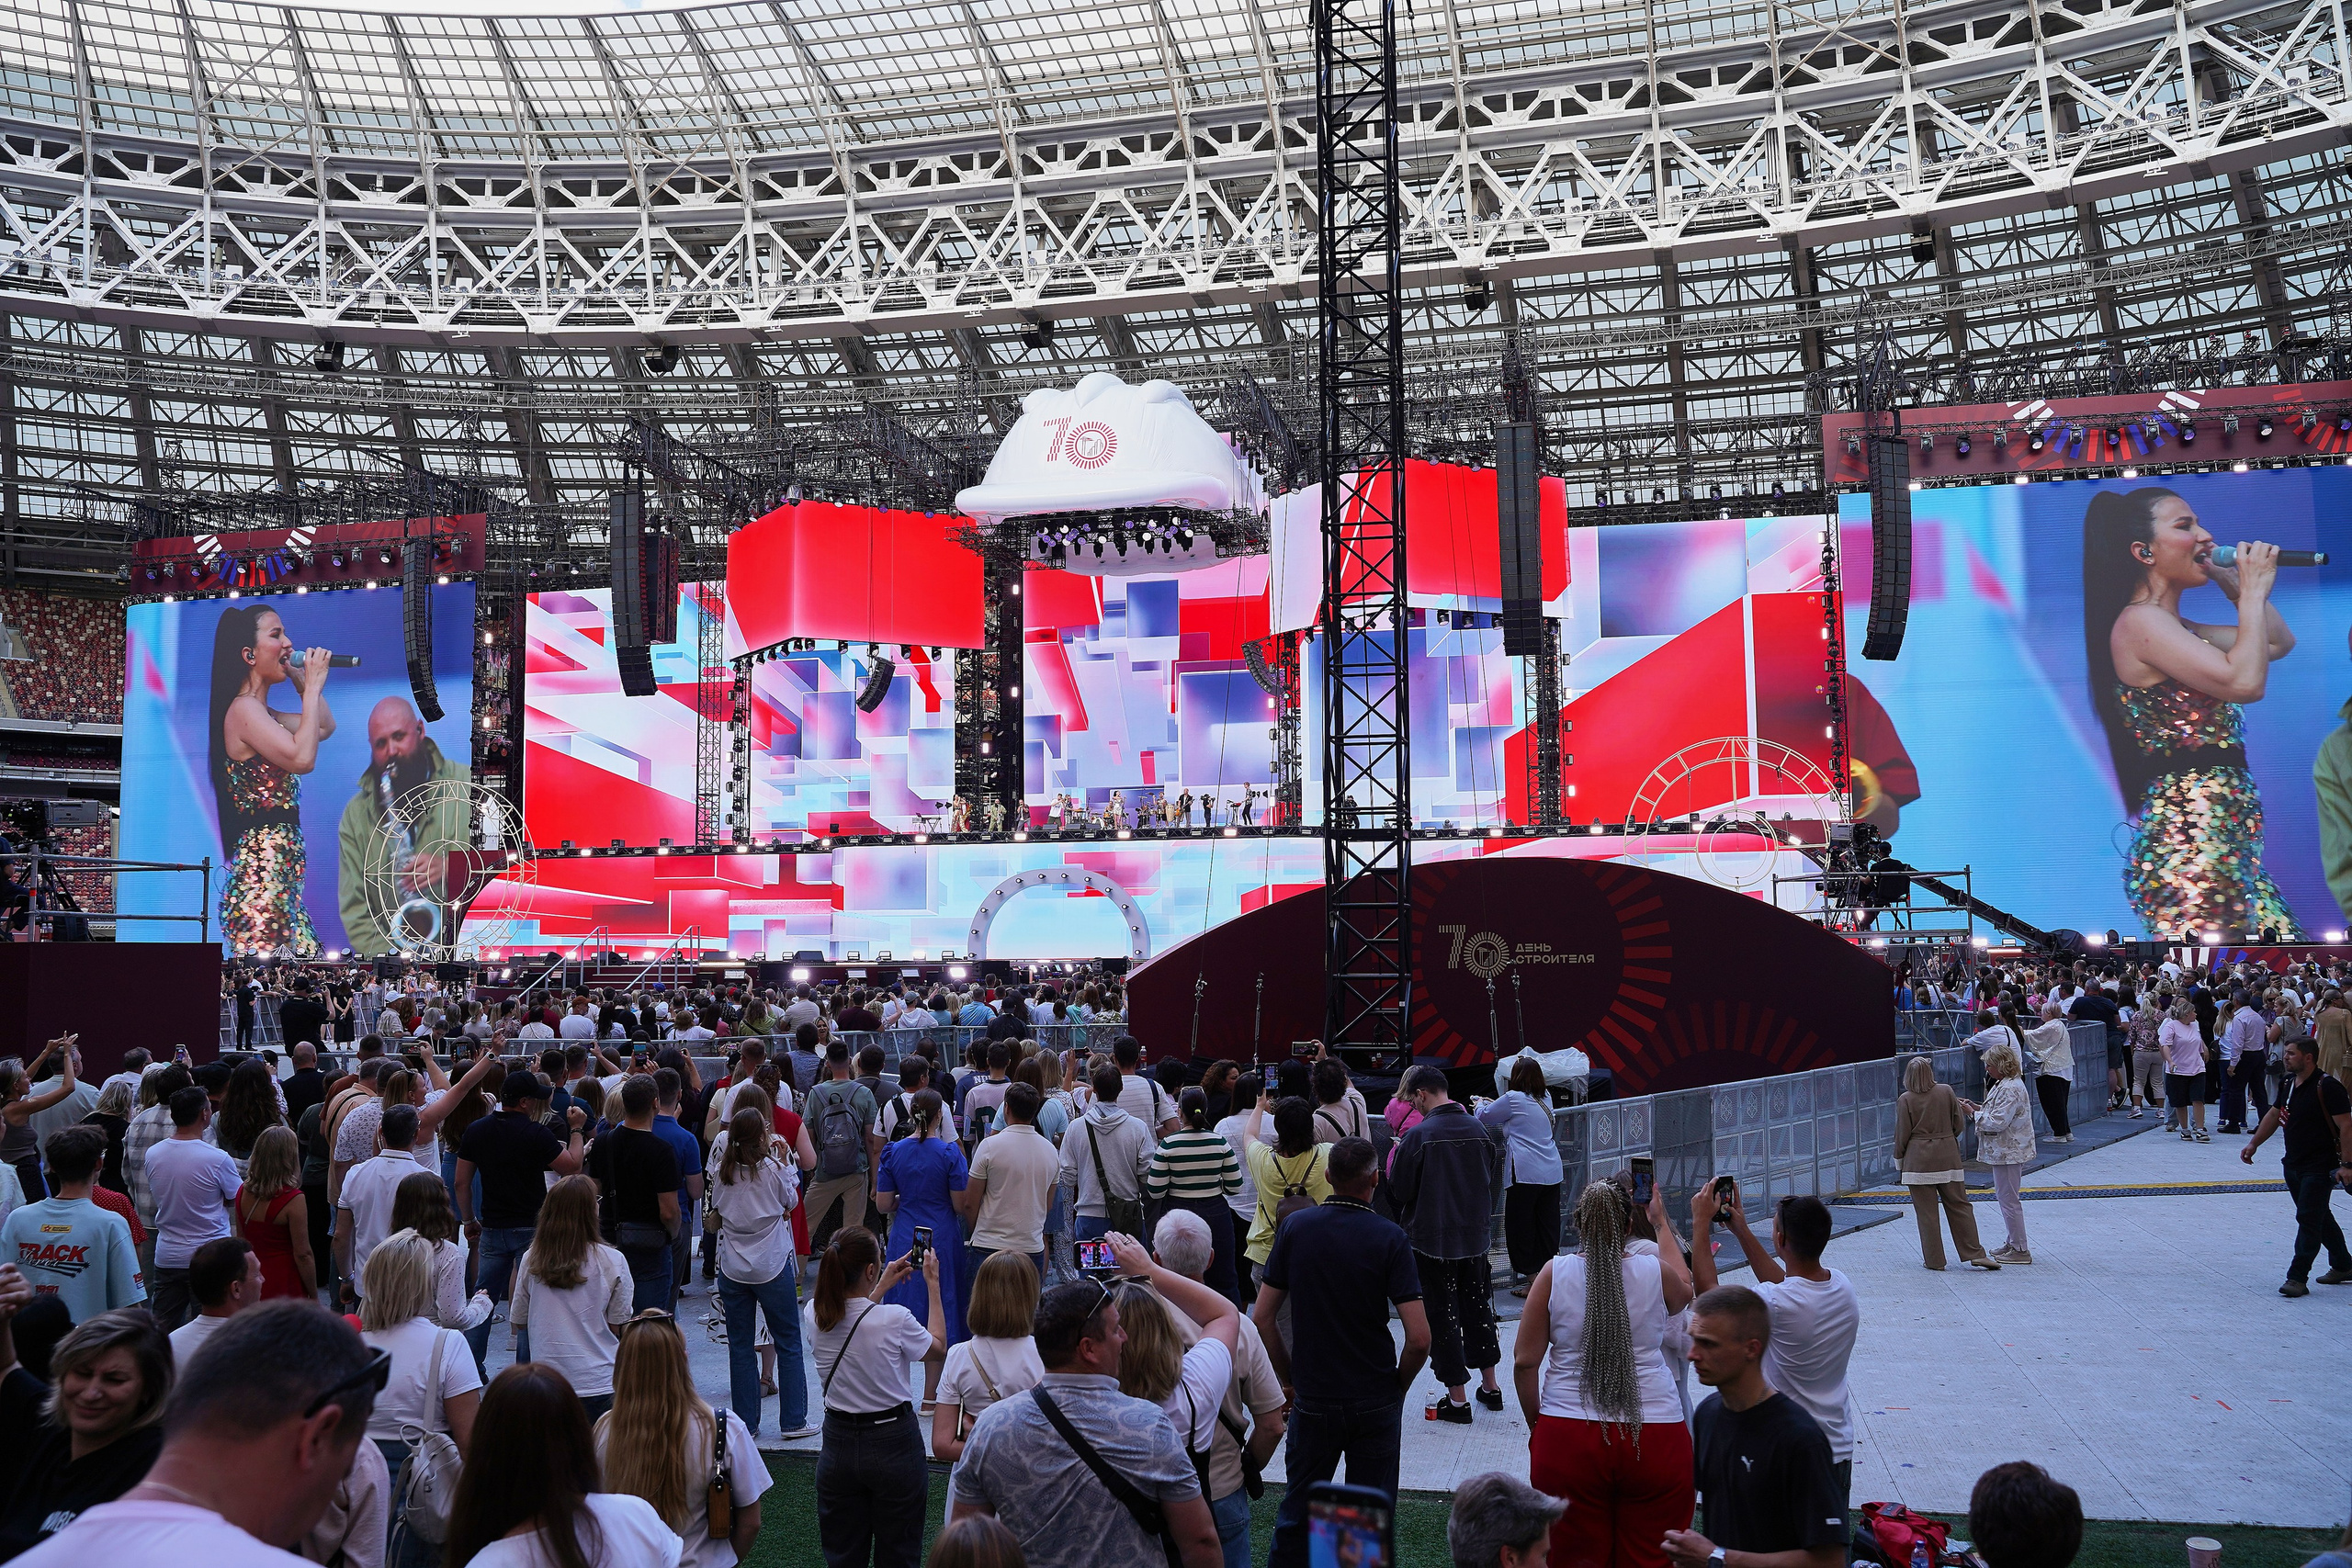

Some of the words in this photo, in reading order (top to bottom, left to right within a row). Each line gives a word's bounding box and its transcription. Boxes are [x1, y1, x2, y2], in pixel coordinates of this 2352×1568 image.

[1515, 942, 1552, 953] ДЕНЬ
[1515, 953, 1595, 964] СТРОИТЕЛЯ
[19, 1243, 90, 1262] TRACK
